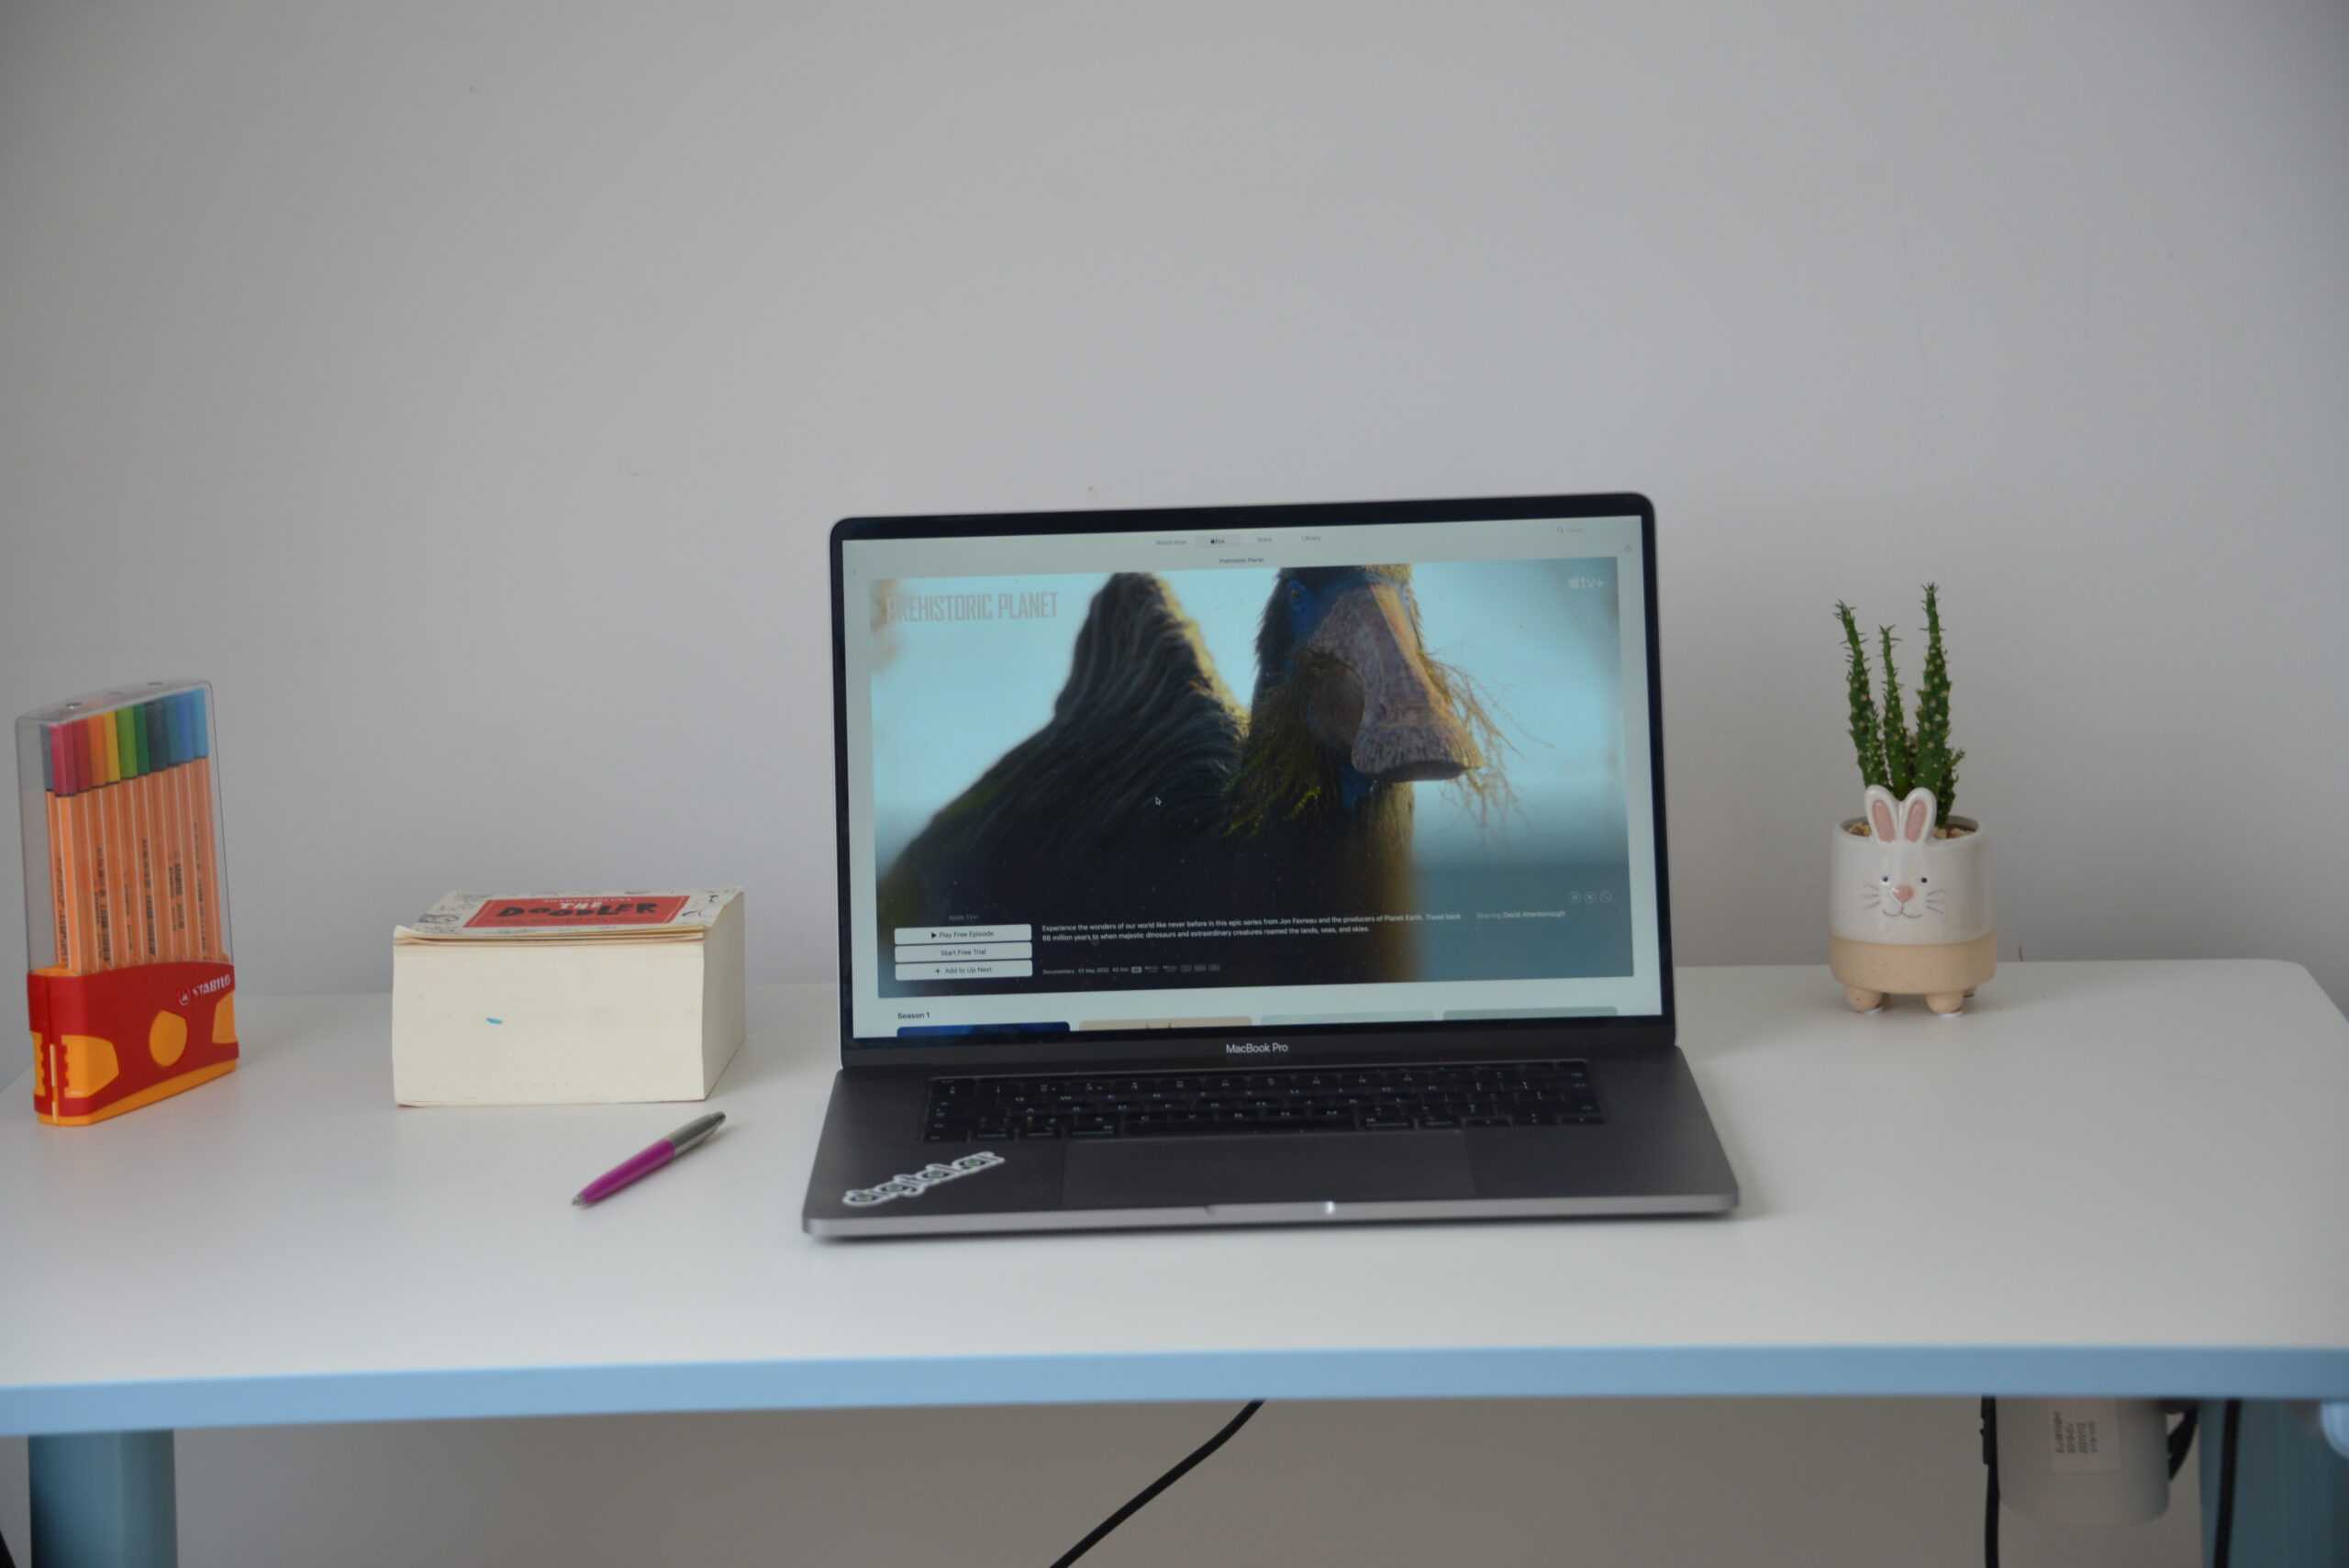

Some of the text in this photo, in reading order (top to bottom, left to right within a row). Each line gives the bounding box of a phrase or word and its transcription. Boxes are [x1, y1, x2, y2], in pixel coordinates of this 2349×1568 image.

[888, 592, 1059, 622] PREHISTORIC PLANET
[495, 903, 658, 917] DOODLER
[1343, 916, 1375, 924] producers
[1074, 934, 1091, 942] years
[1191, 929, 1231, 938] extraordinary
[1300, 927, 1319, 935] lands,
[1226, 1042, 1289, 1054] MacBook Pro
